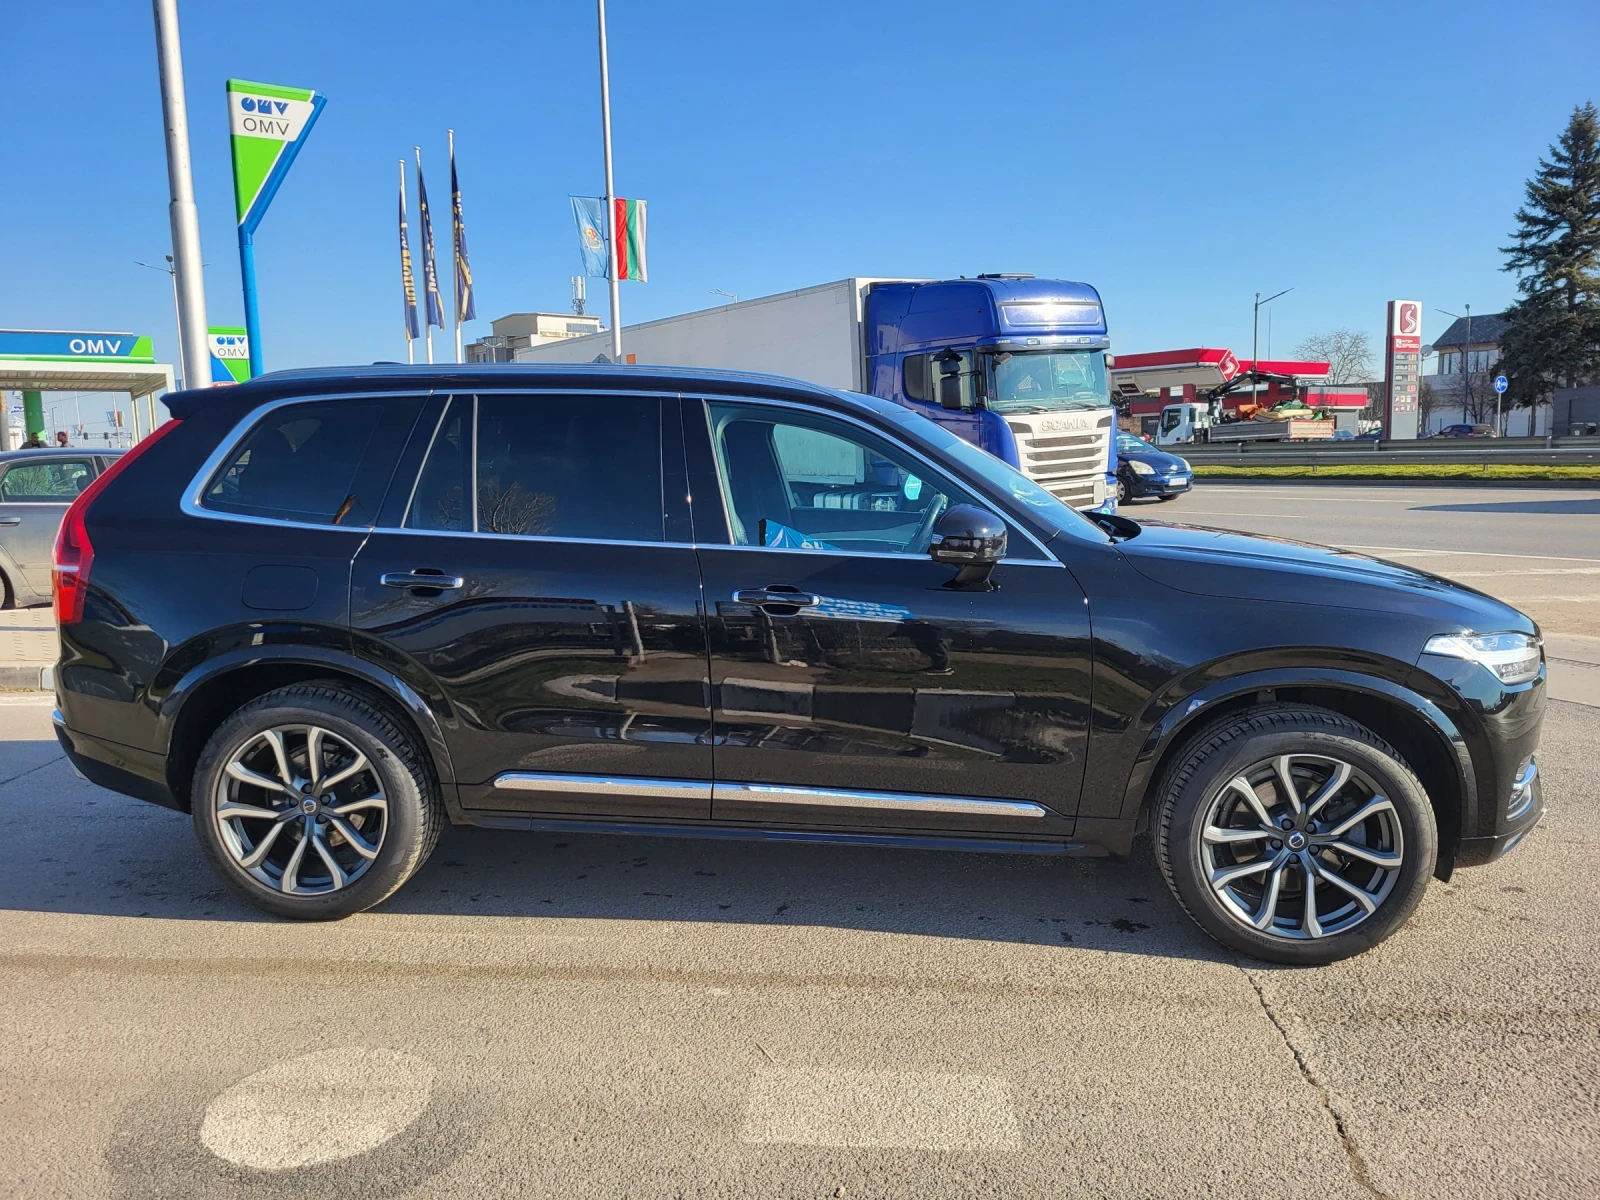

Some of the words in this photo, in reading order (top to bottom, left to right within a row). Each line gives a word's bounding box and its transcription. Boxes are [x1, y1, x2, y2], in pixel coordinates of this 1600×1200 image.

[243, 118, 290, 135] OMV
[69, 339, 121, 354] OMV
[217, 348, 247, 357] OMV
[1041, 418, 1088, 431] SCANIA
